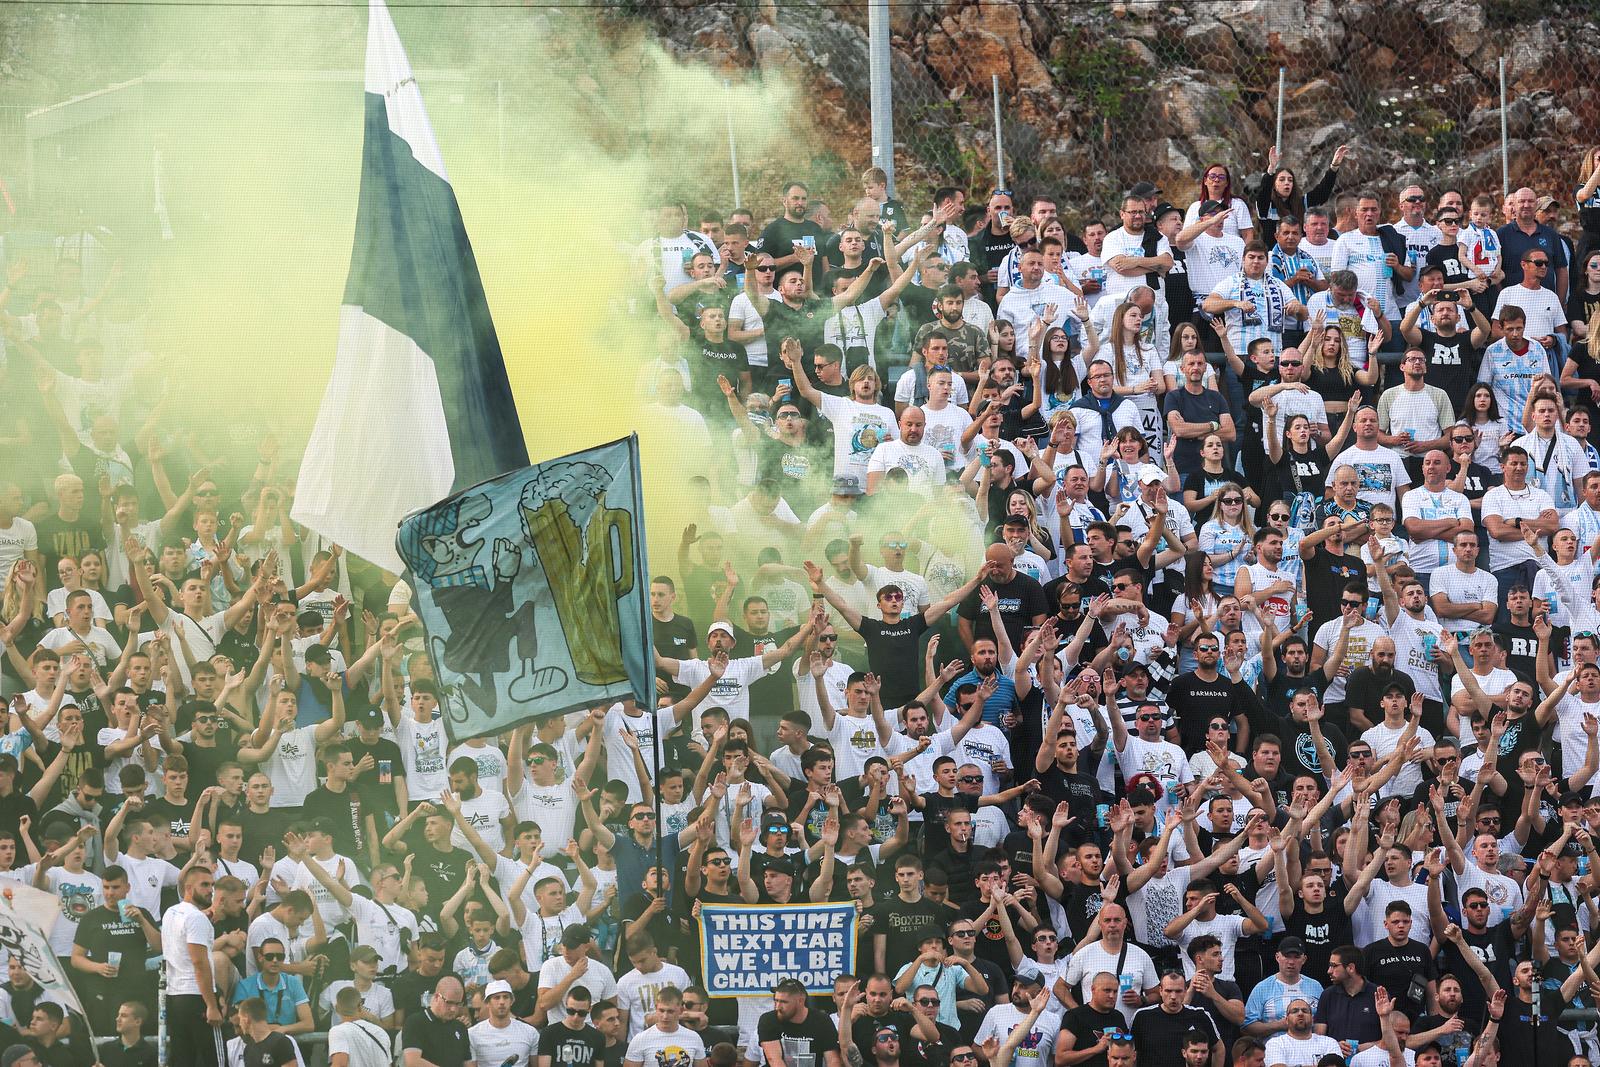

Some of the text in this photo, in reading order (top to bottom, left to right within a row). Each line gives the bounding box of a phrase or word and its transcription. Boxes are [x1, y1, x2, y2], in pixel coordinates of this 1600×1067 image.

[1431, 343, 1461, 365] RI
[1295, 461, 1320, 476] RI
[710, 912, 847, 931] THIS TIME
[712, 932, 844, 950] NEXT YEAR
[808, 950, 843, 970] BE
